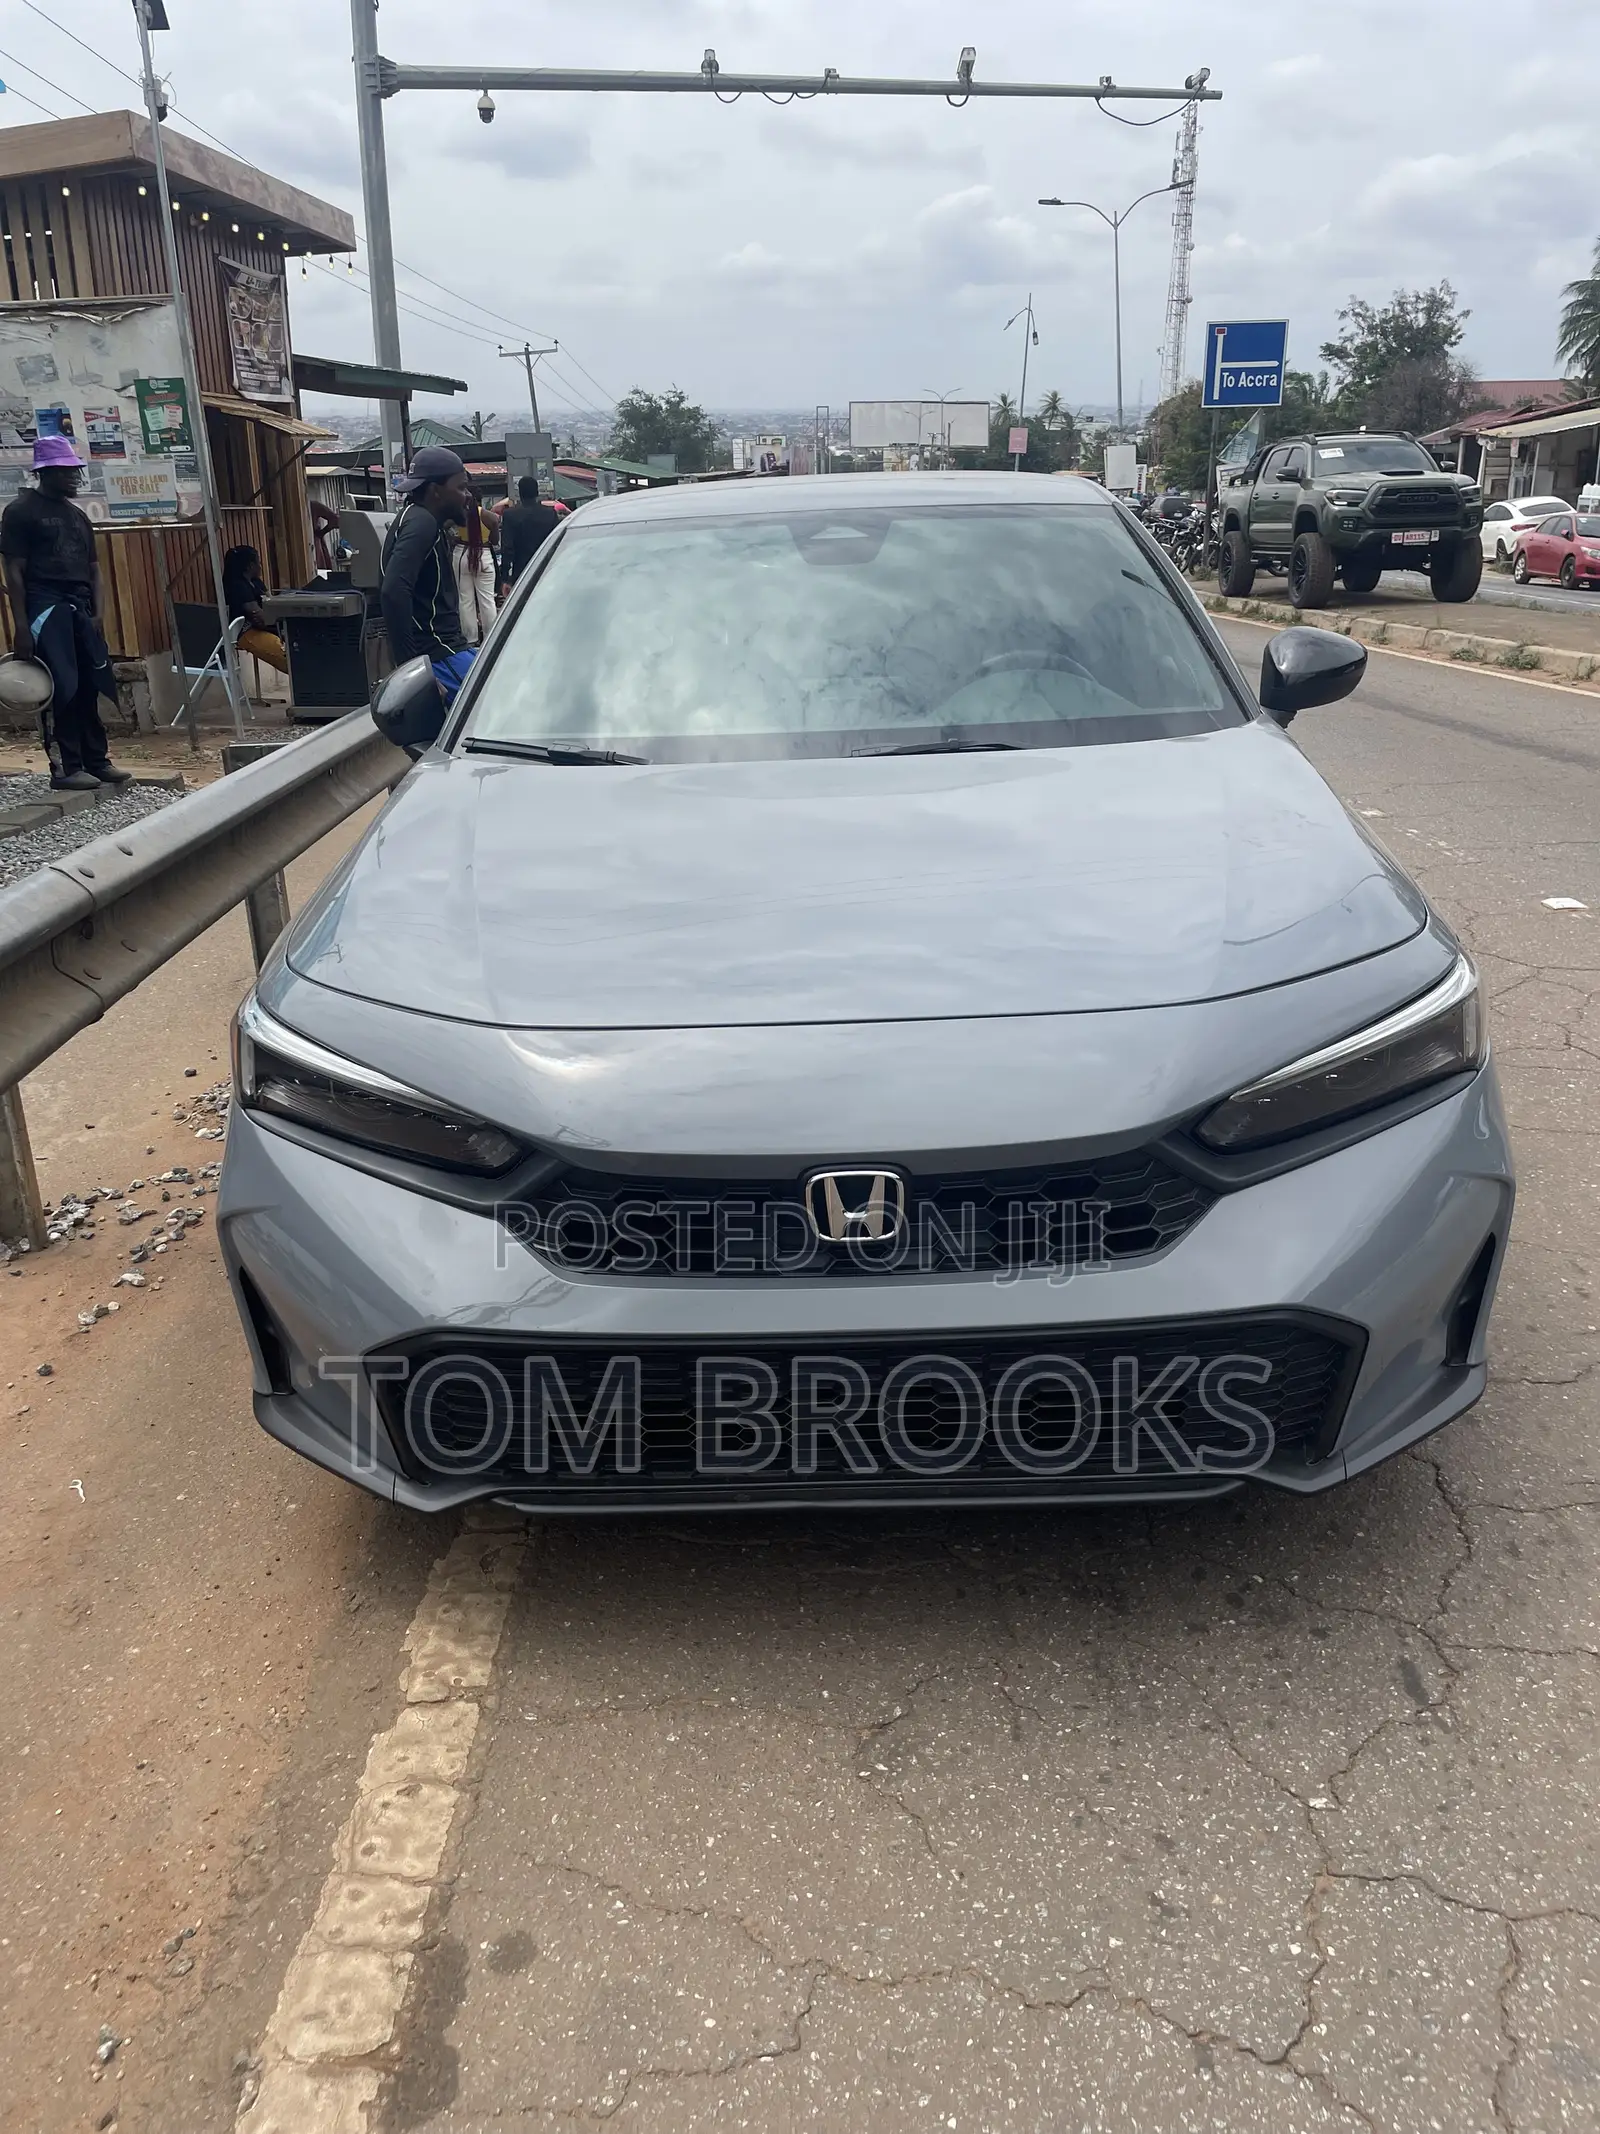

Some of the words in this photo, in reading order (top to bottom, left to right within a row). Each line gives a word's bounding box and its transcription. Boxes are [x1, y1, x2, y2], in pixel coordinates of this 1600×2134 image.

[1222, 372, 1235, 388] To
[1237, 371, 1278, 388] Accra
[120, 483, 138, 495] FOR
[139, 482, 161, 494] SALE
